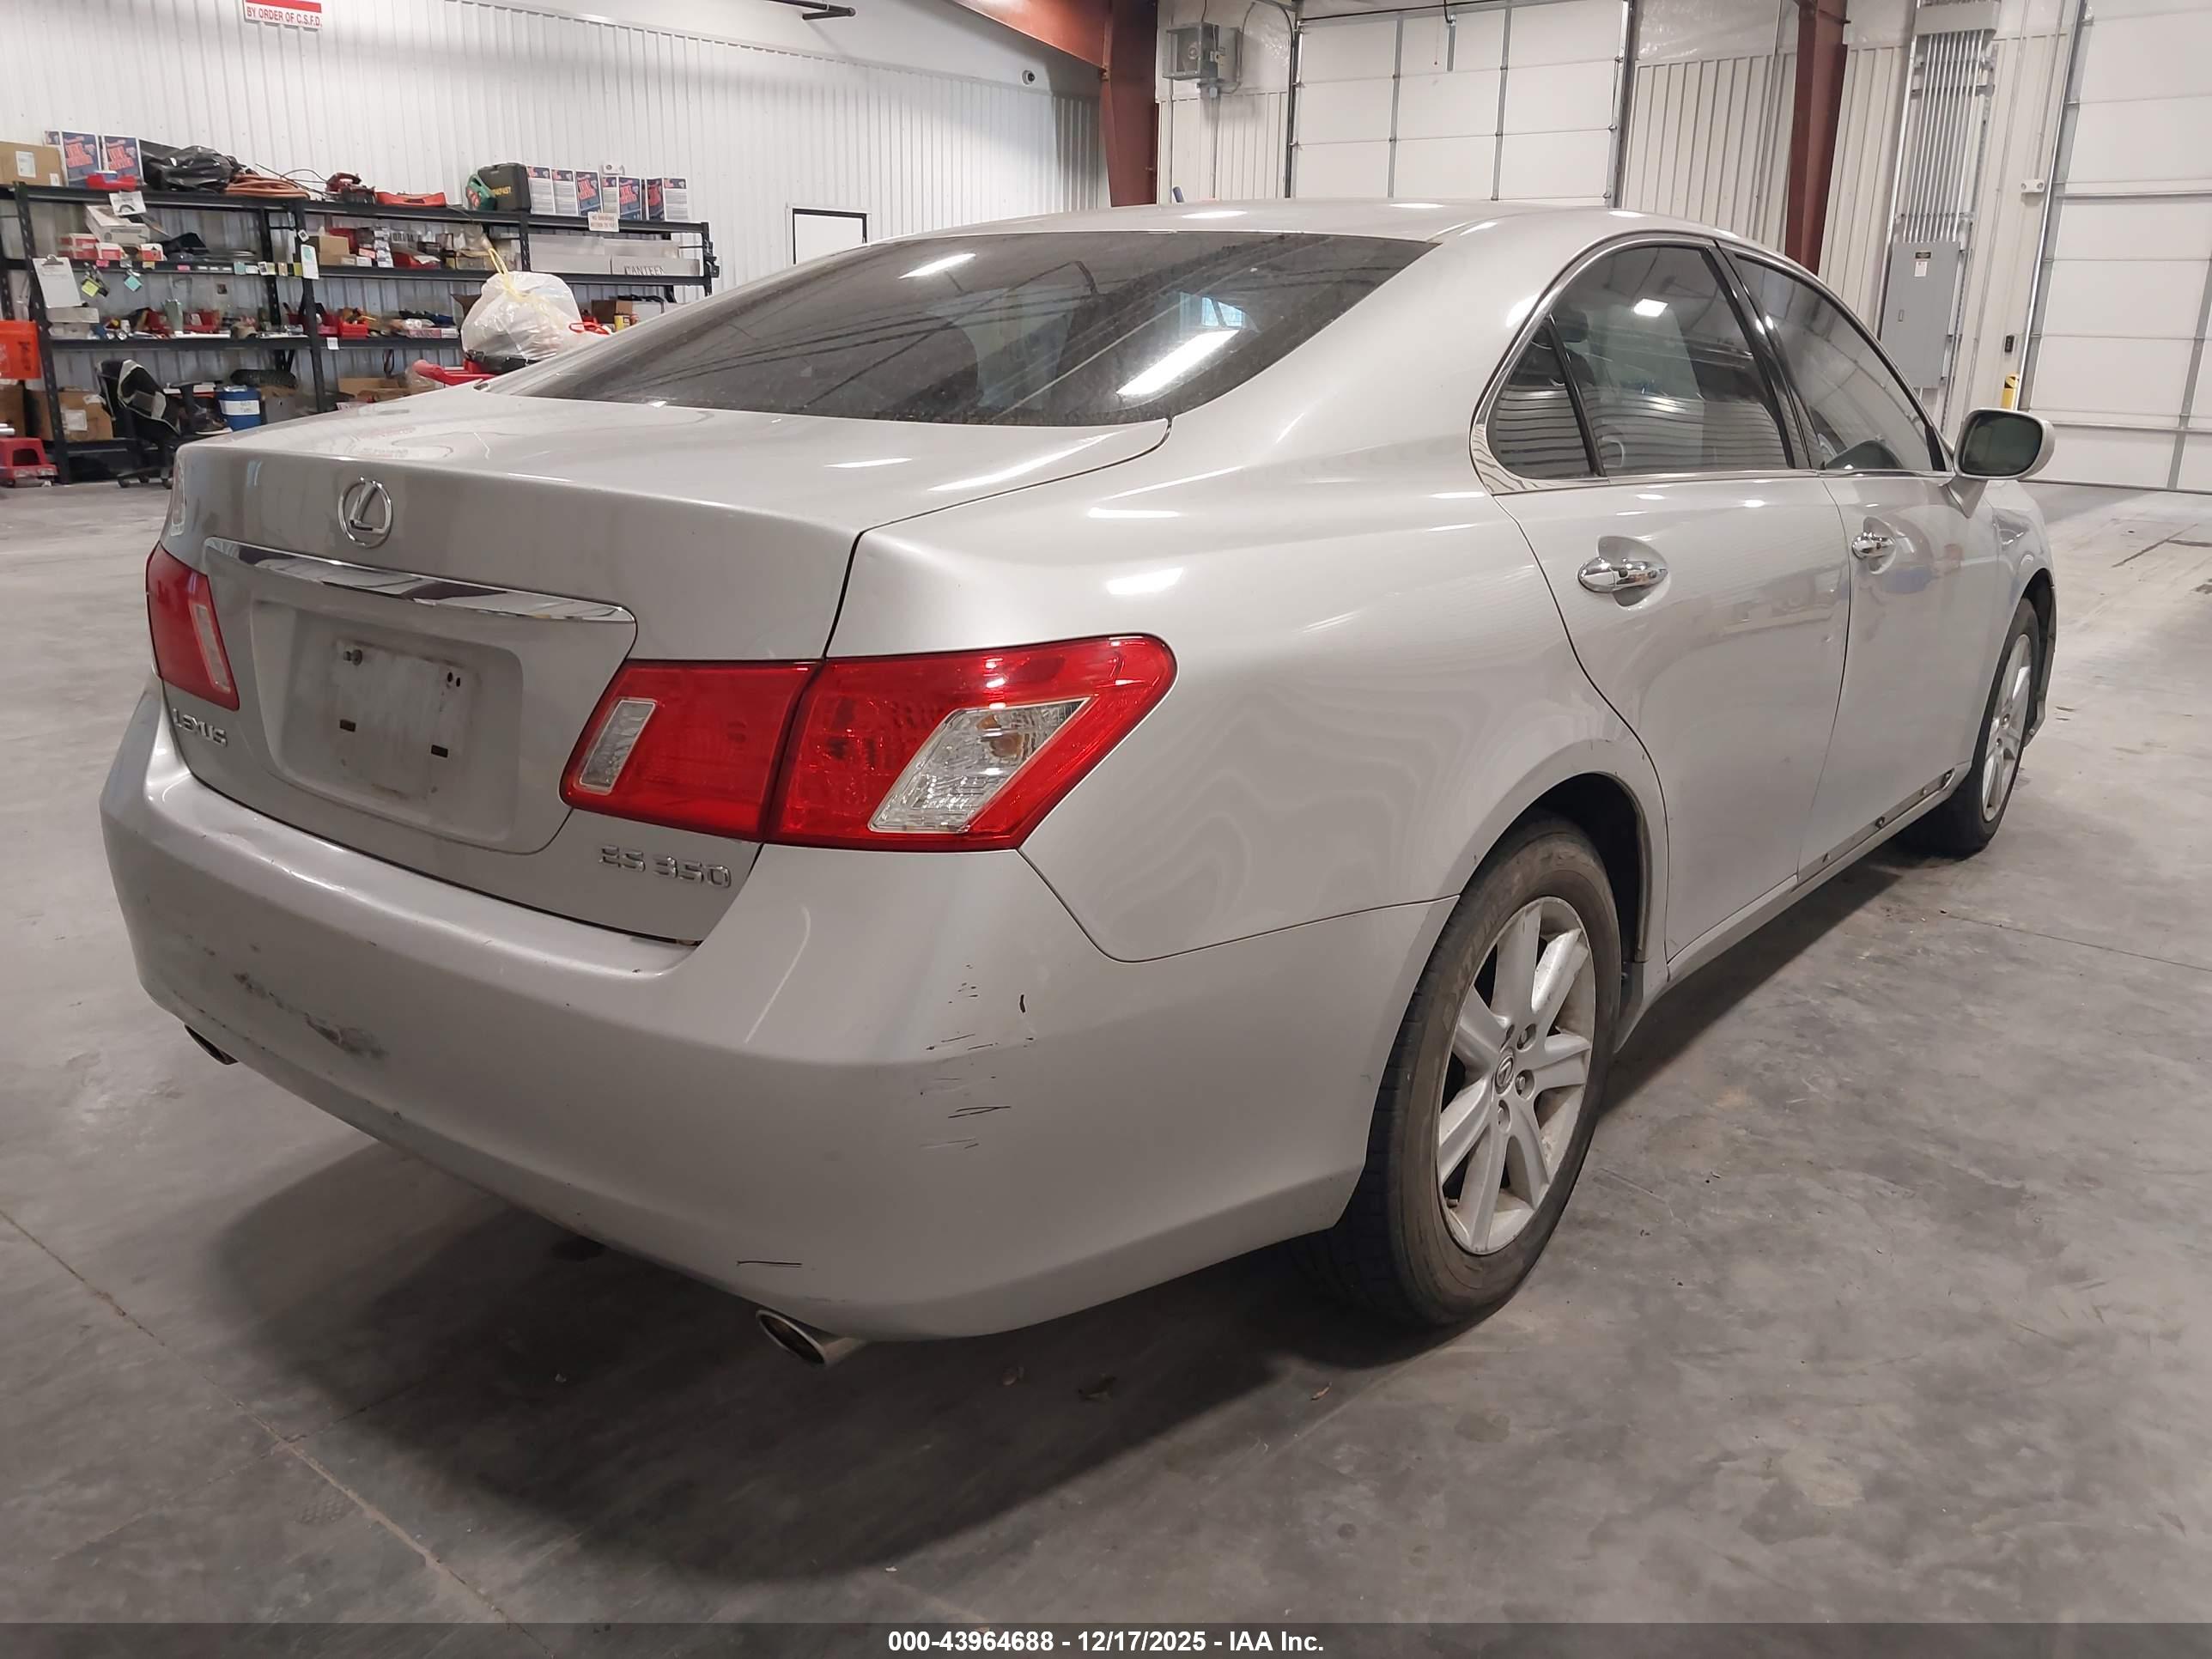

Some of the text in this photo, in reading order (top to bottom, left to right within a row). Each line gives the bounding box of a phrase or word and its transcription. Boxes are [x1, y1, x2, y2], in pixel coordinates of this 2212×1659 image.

[246, 6, 322, 27] BY ORDER OF C.S.F.D.
[599, 845, 732, 888] ES 350
